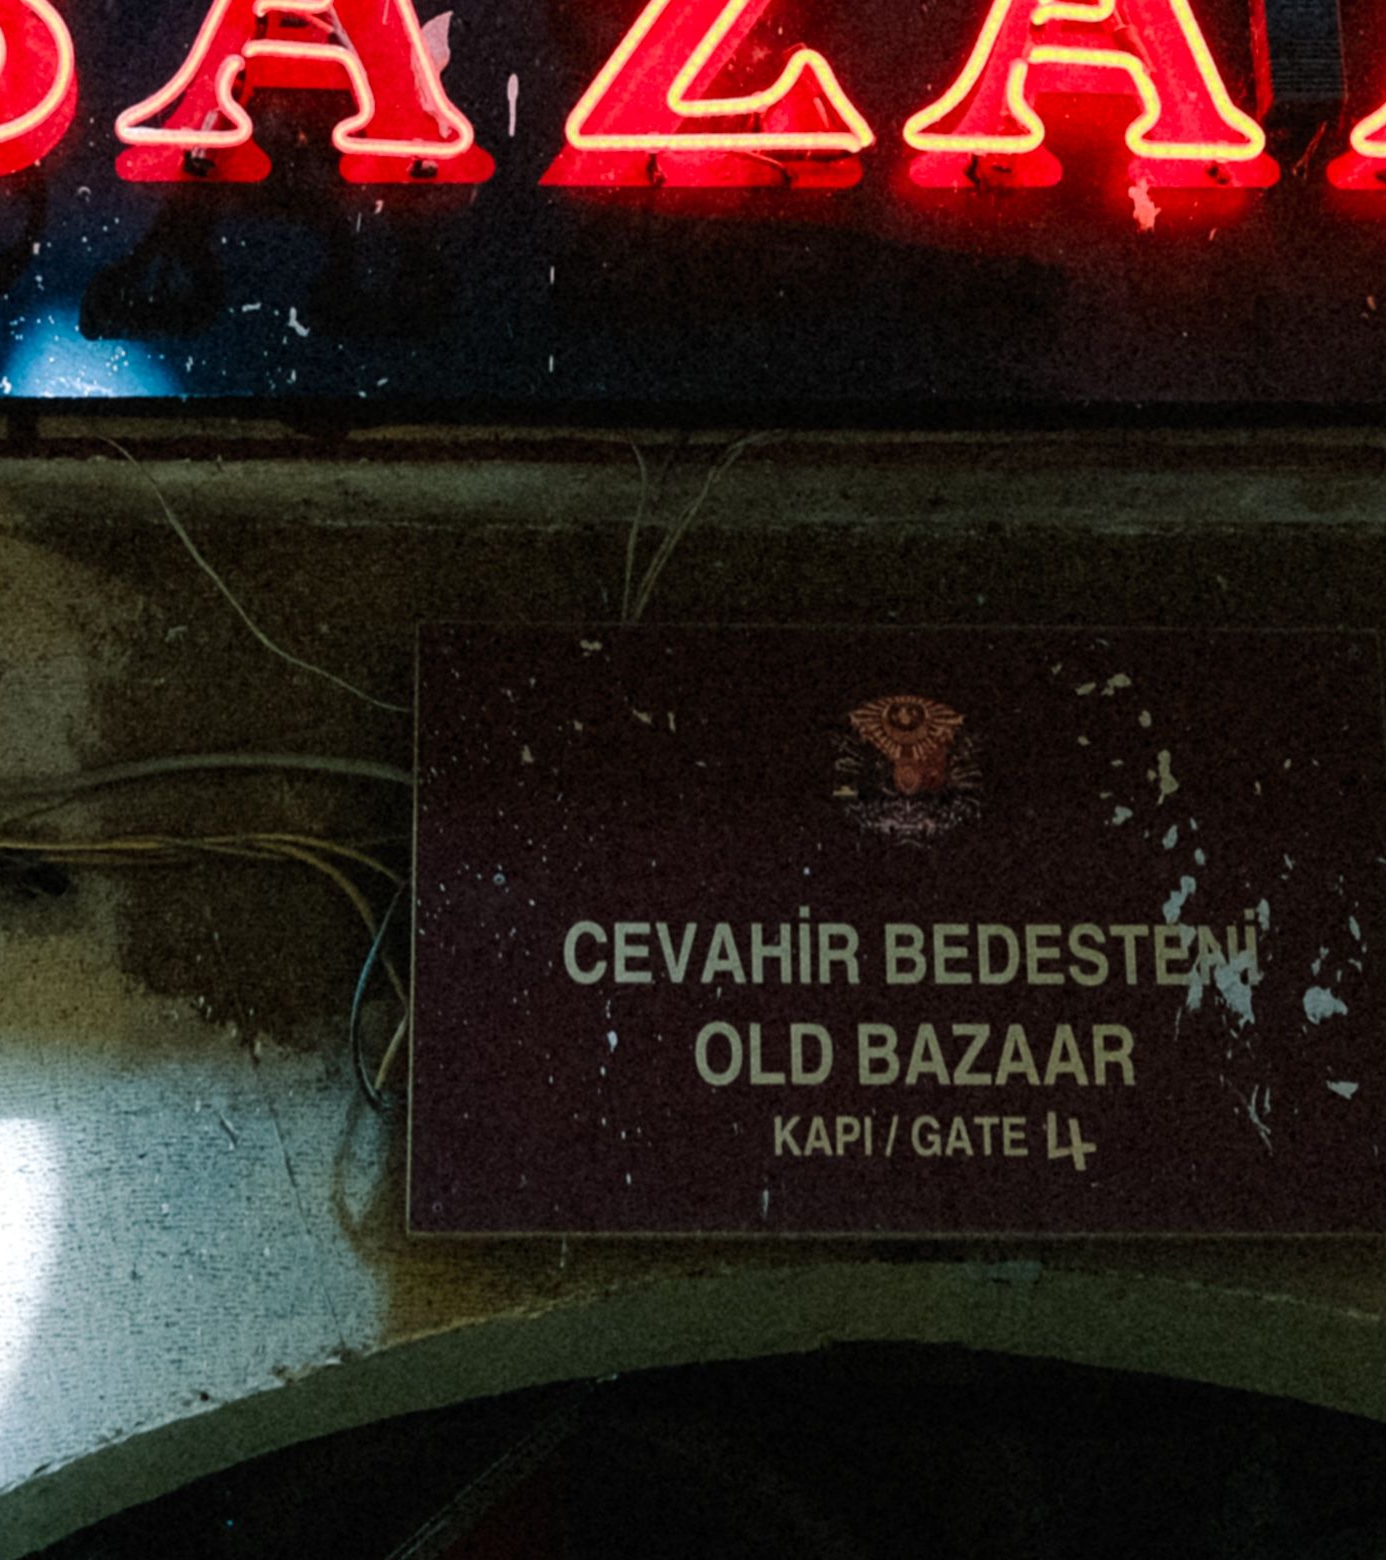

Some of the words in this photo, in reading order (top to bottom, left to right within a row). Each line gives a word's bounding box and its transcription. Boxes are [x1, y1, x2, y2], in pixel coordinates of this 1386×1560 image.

[562, 906, 860, 985] CEVAHİR
[884, 907, 1260, 987] BEDESTENİ
[694, 1021, 833, 1087] OLD
[858, 1022, 1136, 1087] BAZAAR
[773, 1115, 874, 1158] KAPI
[884, 1116, 899, 1157] /
[909, 1116, 1029, 1158] GATE
[1045, 1111, 1097, 1171] 4
